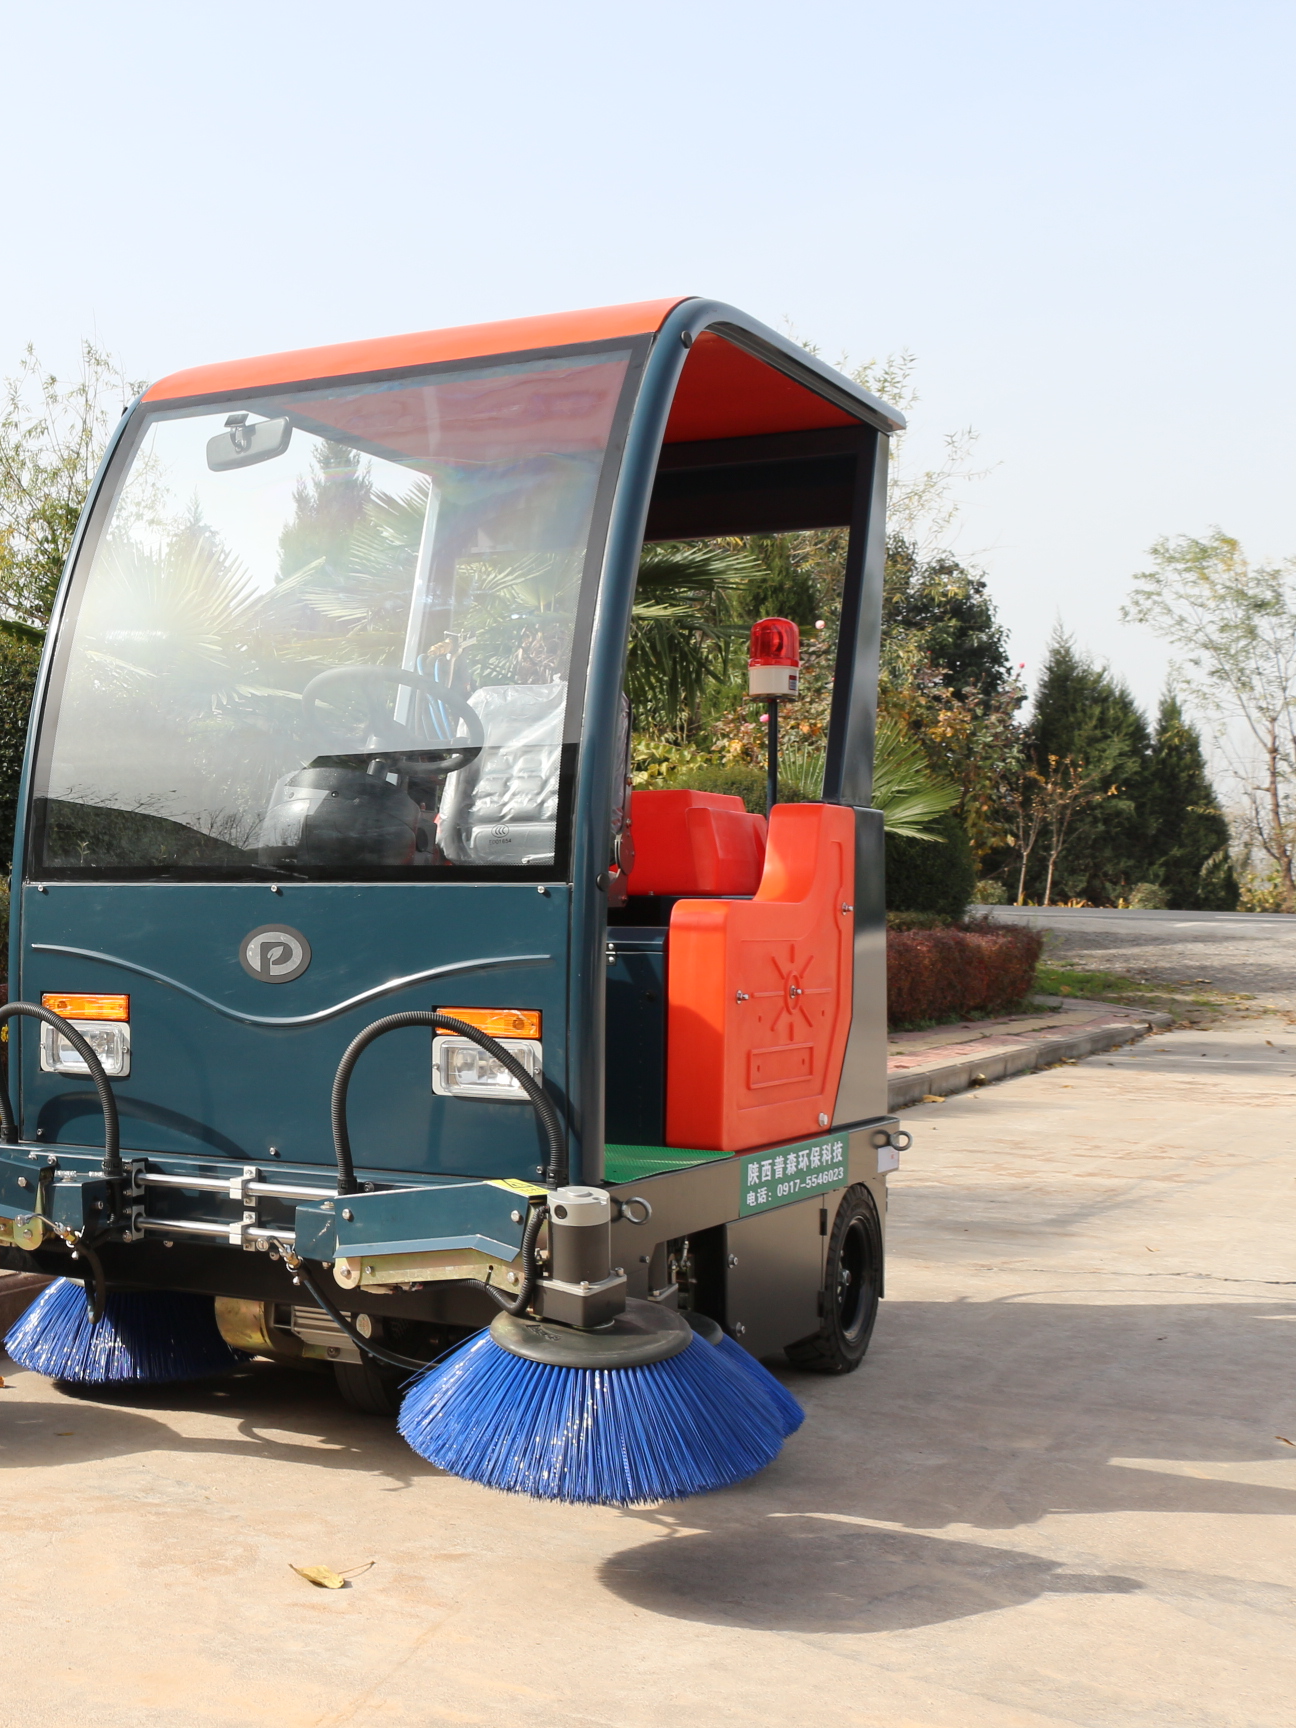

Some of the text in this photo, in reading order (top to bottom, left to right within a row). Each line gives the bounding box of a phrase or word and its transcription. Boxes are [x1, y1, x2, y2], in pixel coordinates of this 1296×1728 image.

[747, 1141, 843, 1186] 陕西普森环保科技
